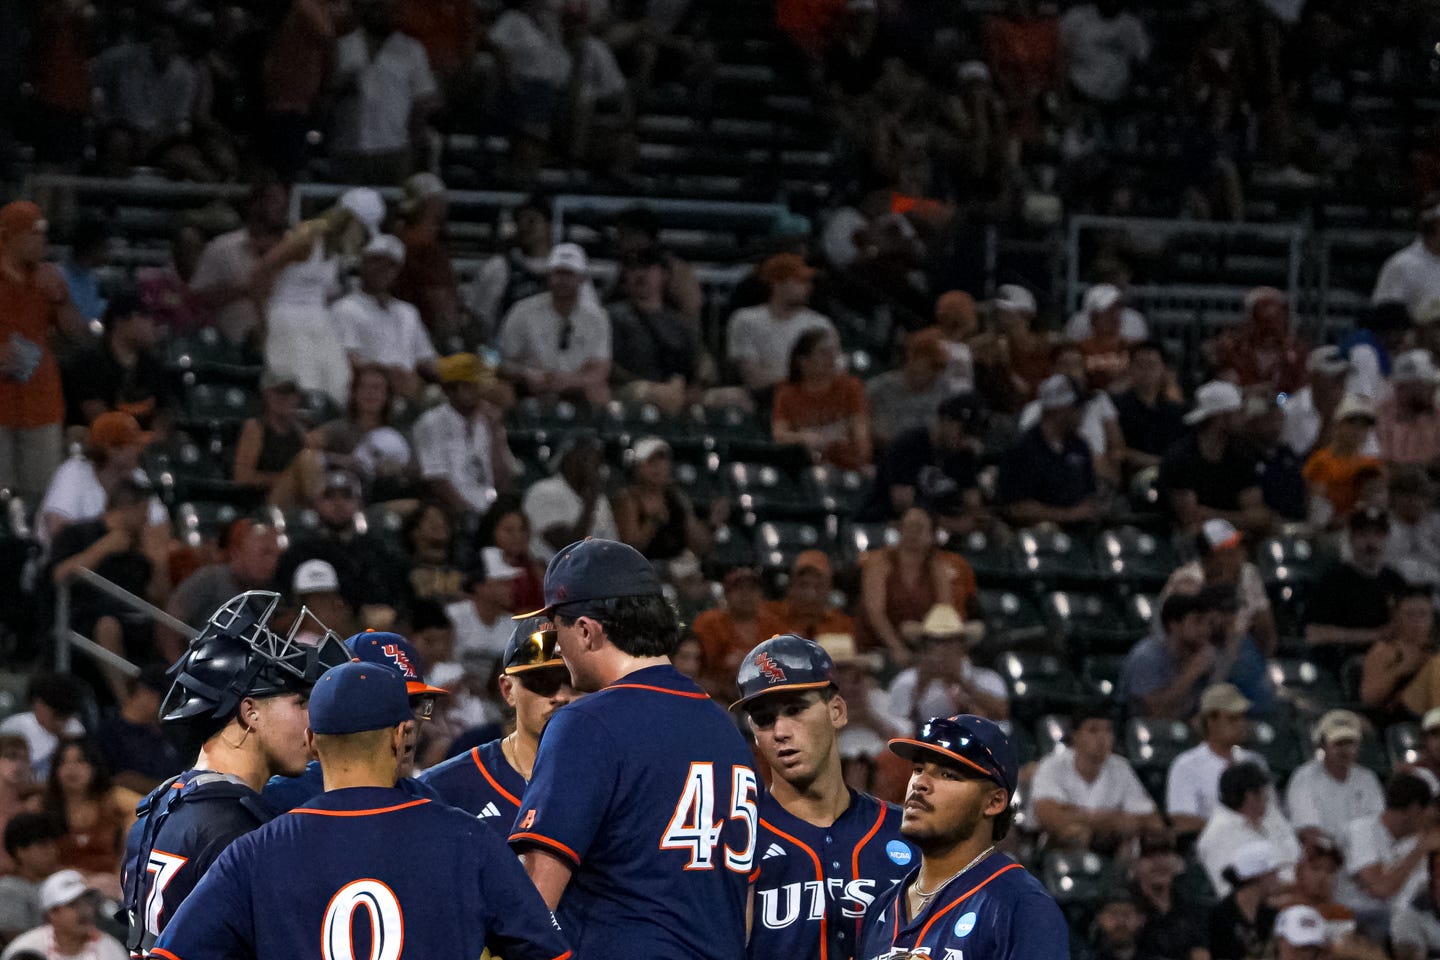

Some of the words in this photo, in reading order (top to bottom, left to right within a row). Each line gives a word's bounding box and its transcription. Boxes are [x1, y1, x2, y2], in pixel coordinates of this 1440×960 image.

[659, 762, 757, 874] 45
[889, 851, 911, 860] NCAA
[757, 877, 902, 930] UTS
